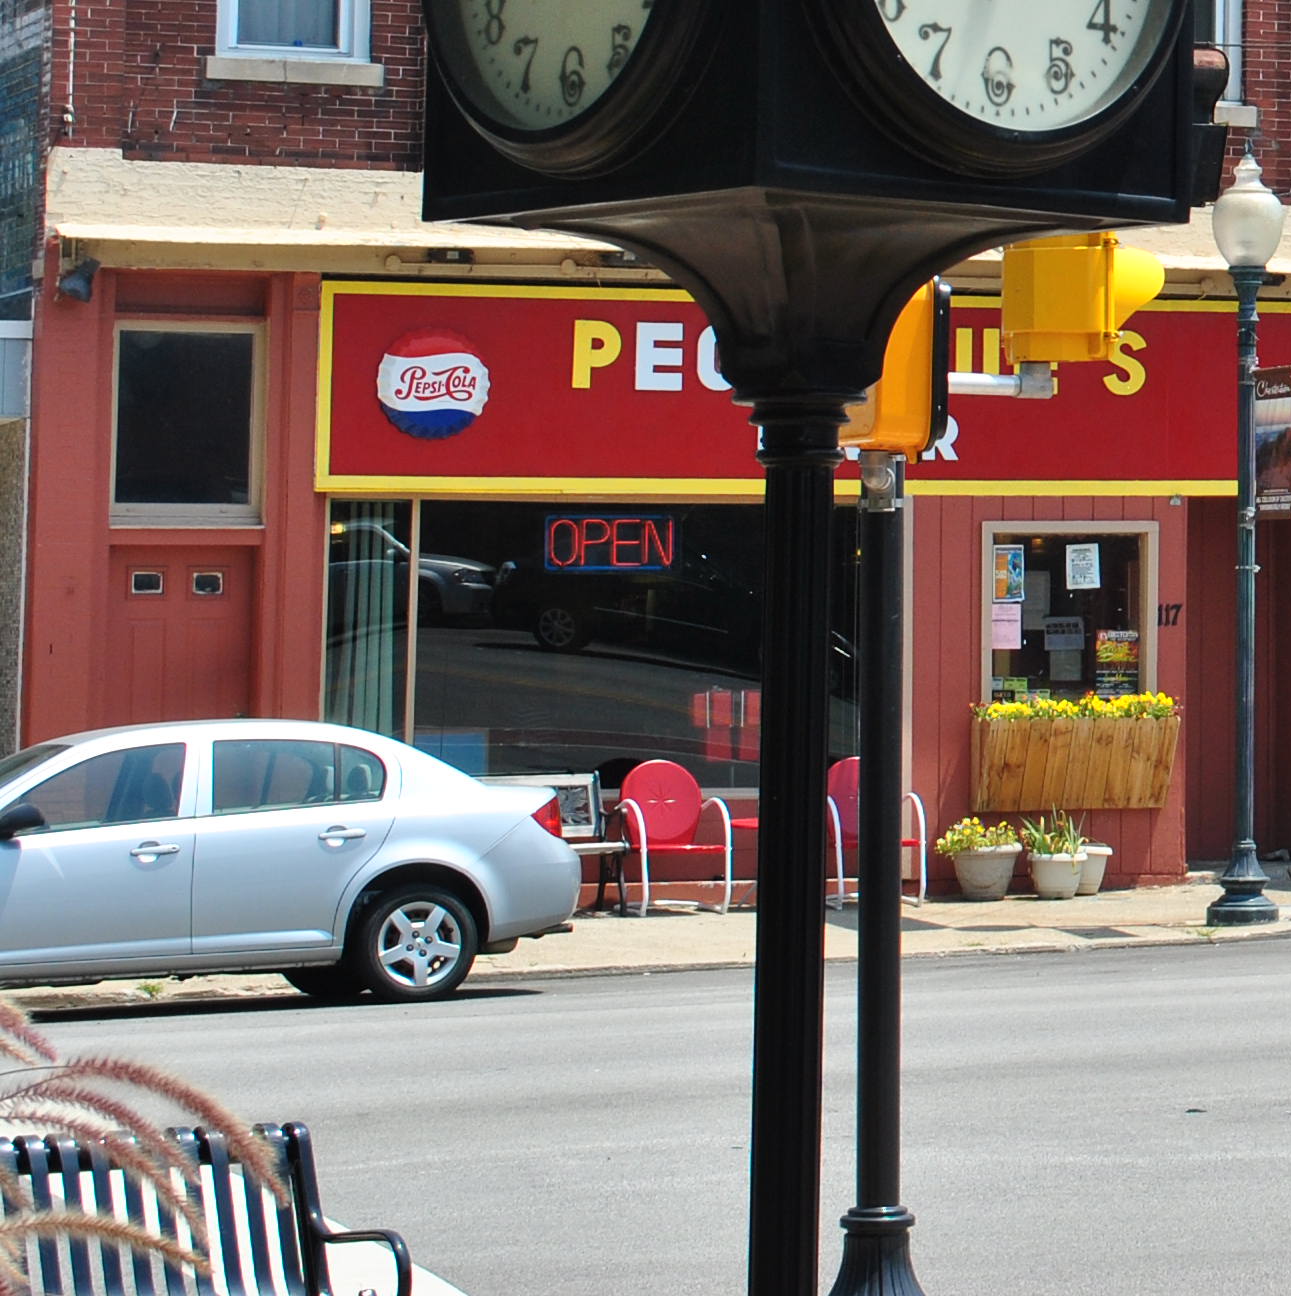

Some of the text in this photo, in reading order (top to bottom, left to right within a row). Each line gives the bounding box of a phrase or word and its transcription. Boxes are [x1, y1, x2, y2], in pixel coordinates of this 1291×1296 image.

[513, 35, 539, 93] 7
[559, 46, 585, 106] 6
[918, 22, 952, 81] 7
[982, 47, 1015, 106] 6
[1046, 37, 1075, 95] 5
[547, 516, 674, 570] OPEN
